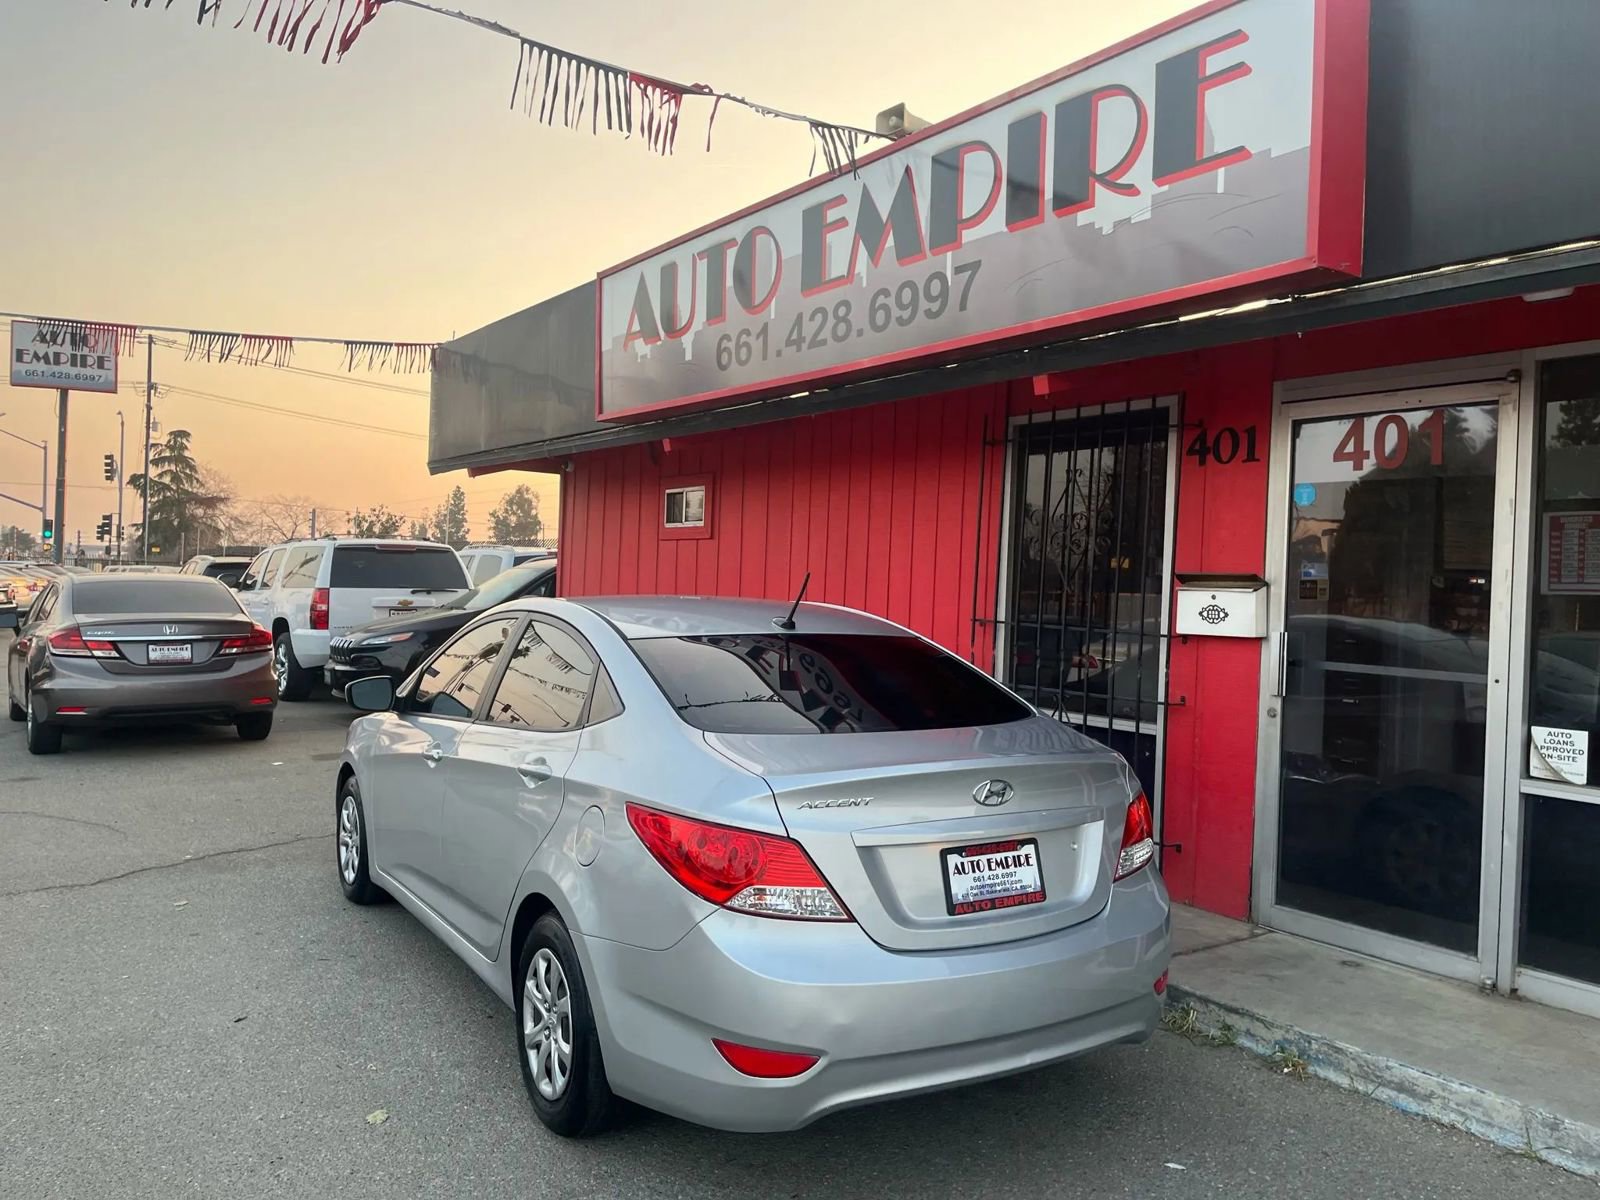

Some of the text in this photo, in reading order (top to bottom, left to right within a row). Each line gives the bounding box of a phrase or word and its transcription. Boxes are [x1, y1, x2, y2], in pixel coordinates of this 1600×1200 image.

[623, 28, 1253, 351] AUTO EMPIRE
[715, 259, 983, 372] 661.428.6997
[31, 328, 98, 349] AUTO
[15, 348, 113, 371] EMPIRE
[24, 369, 103, 382] 661.428.6997
[1186, 423, 1261, 467] 401
[1332, 408, 1446, 471] 401
[1543, 738, 1575, 747] LOANS
[1547, 731, 1572, 739] AUTO
[1539, 745, 1585, 756] PPROVED
[797, 797, 874, 810] ACCENT
[953, 853, 1034, 876] AUTO EMPIRE
[973, 871, 1017, 883] 661.428.6997
[954, 891, 1044, 914] AUTO EMPIRE
